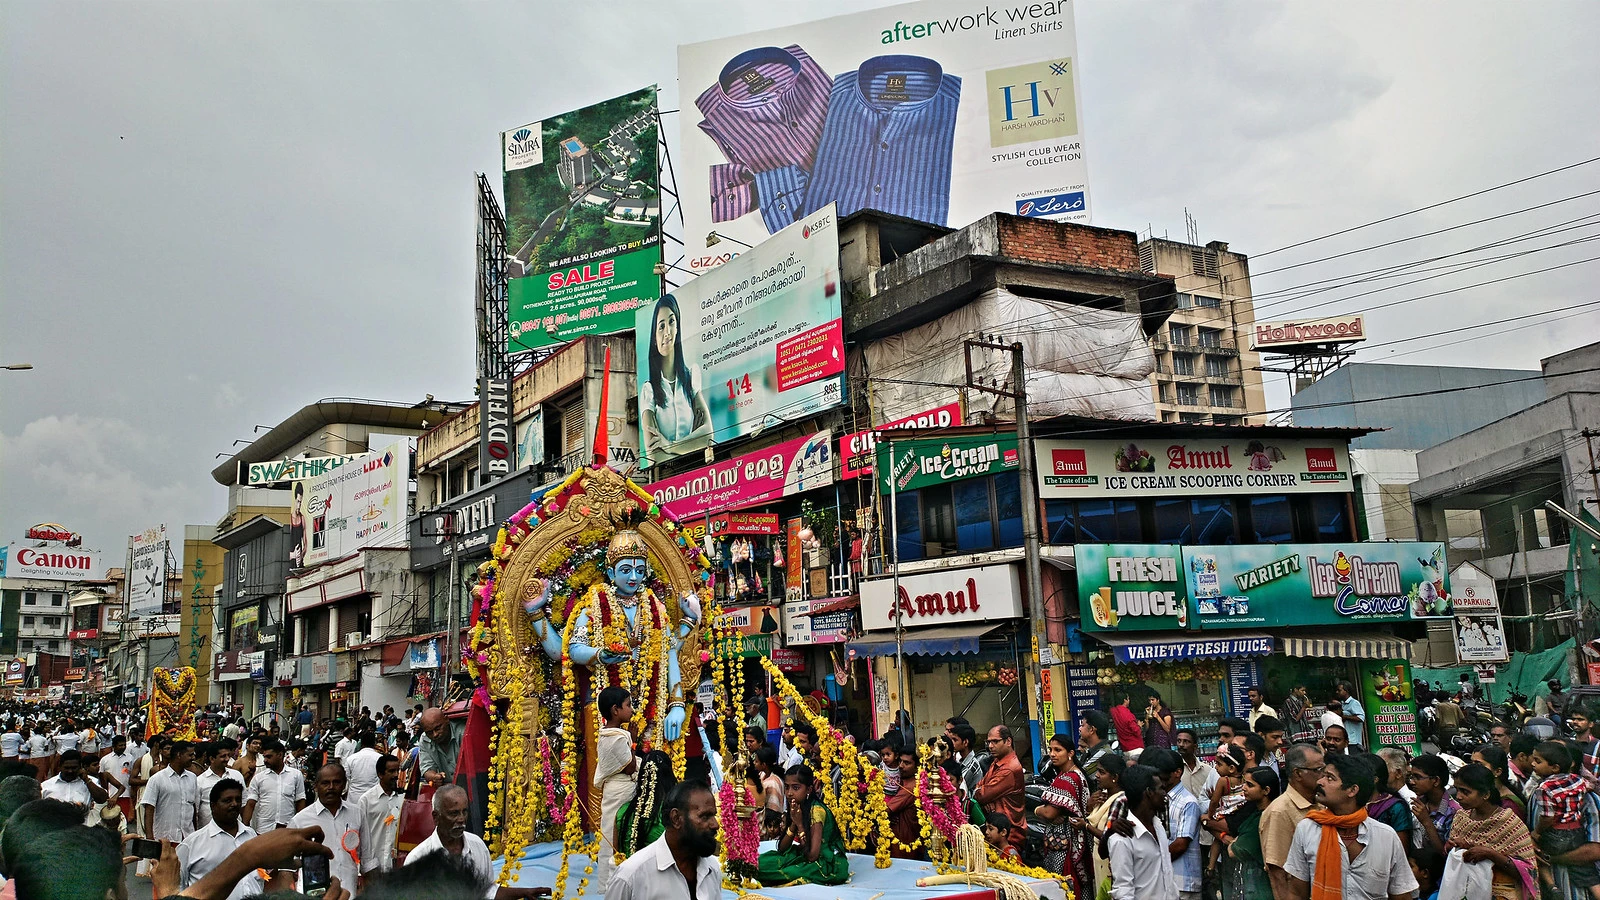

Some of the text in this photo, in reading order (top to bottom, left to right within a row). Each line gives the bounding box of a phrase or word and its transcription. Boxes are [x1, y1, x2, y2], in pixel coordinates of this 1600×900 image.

[881, 0, 1067, 44] afterwork wear
[994, 20, 1063, 40] Linen Shirts
[999, 81, 1061, 122] Hv
[1001, 116, 1066, 132] HARSH VARDHAN
[512, 151, 537, 160] PROPERTIES
[992, 142, 1080, 163] STYLISH CLUB WEAR
[1026, 152, 1082, 167] COLLECTION
[1021, 190, 1042, 198] QUALITY
[1070, 184, 1085, 192] FROM
[811, 215, 830, 232] KSBTC
[560, 257, 571, 266] ARE
[572, 253, 588, 264] ALSO
[590, 247, 617, 259] LOOKING
[618, 244, 626, 252] TO
[628, 240, 641, 249] BUY
[642, 235, 658, 246] LAND
[548, 260, 614, 290] SALE
[548, 288, 566, 298] READY
[574, 284, 590, 293] BUILD
[590, 279, 614, 290] PROJECT
[555, 291, 592, 304] MANGALAPURAM
[608, 280, 638, 290] TRIVANDRUM
[700, 279, 749, 310] കേൾക്കാതെ
[550, 304, 558, 312] 2.6
[559, 302, 576, 310] acres.
[701, 314, 714, 327] ഒരു
[716, 296, 742, 319] ജീവൻ
[558, 324, 598, 337] www.simra.co
[1256, 318, 1361, 343] Hollywood
[794, 342, 806, 352] 0471
[782, 360, 828, 380] www.keralablood.com
[726, 373, 752, 400] 1:4
[736, 400, 744, 409] the
[744, 398, 753, 406] one
[487, 379, 509, 472] BODYFIT
[850, 431, 882, 454] GIFT
[885, 447, 916, 487] VRIETY
[920, 443, 999, 475] Ice Cream
[1056, 460, 1084, 472] Amul
[1167, 444, 1232, 470] Amul
[1309, 458, 1334, 468] Amul
[312, 482, 328, 493] PRODUCT
[328, 478, 338, 488] FROM
[345, 470, 358, 482] HOUSE
[358, 468, 362, 476] OF
[364, 456, 383, 474] LUX
[653, 459, 742, 505] ചൈനീസ്
[744, 454, 784, 480] മേള
[940, 460, 991, 480] Corner
[1104, 474, 1298, 490] ICE CREAM SCOOPING CORNER
[356, 520, 388, 539] HAPPY ONAM
[17, 549, 91, 570] Canon
[1107, 557, 1178, 582] FRESH
[21, 568, 50, 576] Delighting
[1236, 555, 1300, 592] VARIETY
[1307, 555, 1401, 597] Ice Cream
[888, 577, 980, 621] Amul
[1115, 591, 1178, 617] JUICE
[1334, 586, 1410, 616] Corner
[1454, 598, 1492, 606] NO PARKING
[1128, 639, 1268, 660] VARIETY FRESH JUICE
[1374, 714, 1415, 723] FRUIT SALAD
[1376, 724, 1416, 734] FRESH JUICE
[1380, 734, 1416, 744] ICE CREAM
